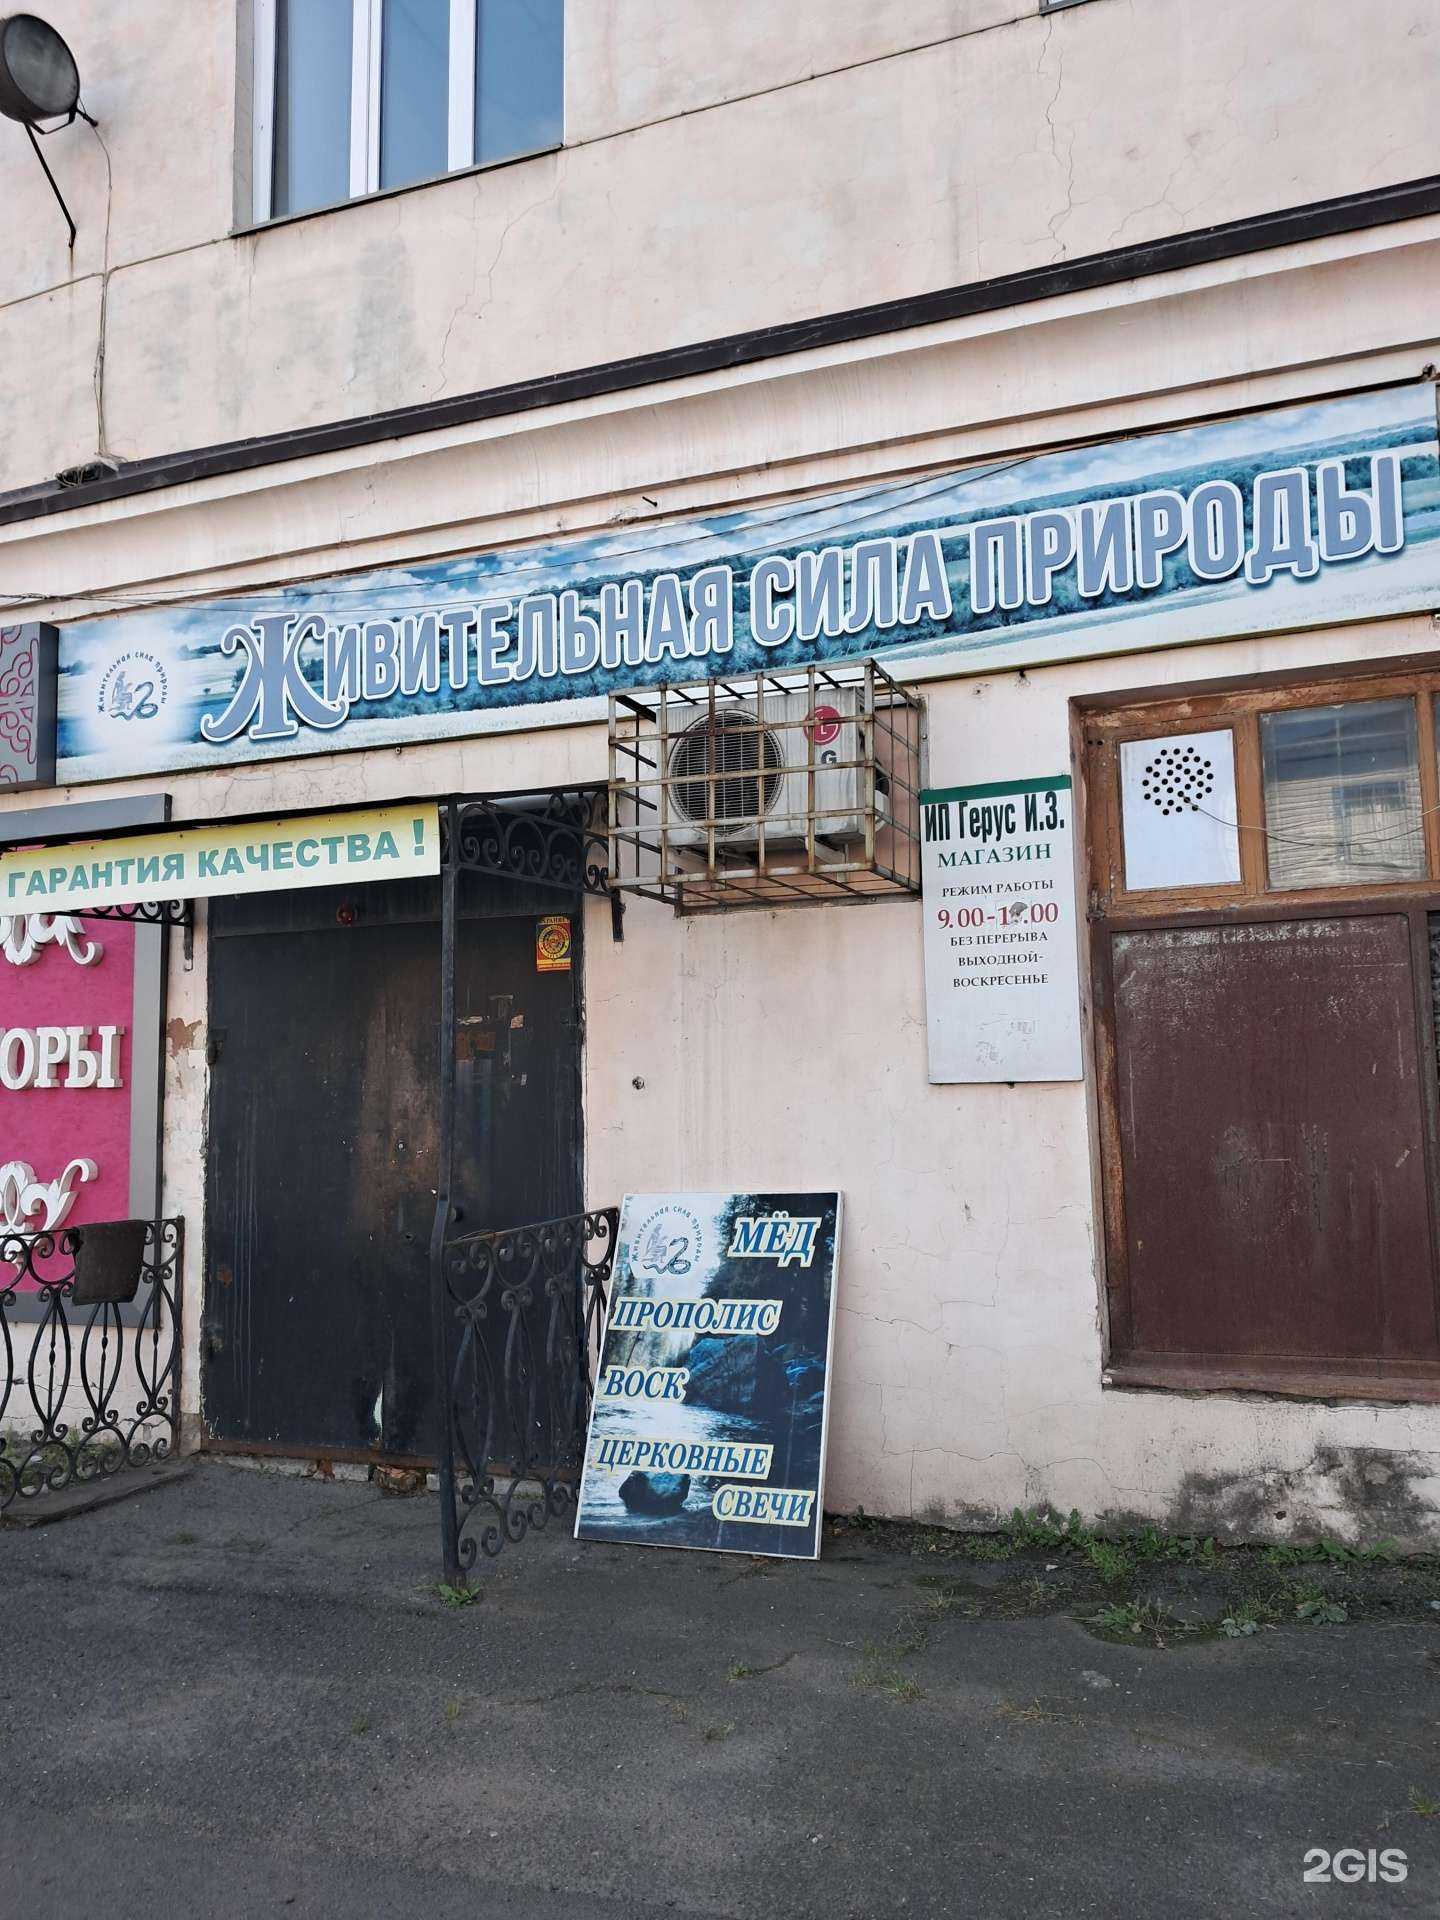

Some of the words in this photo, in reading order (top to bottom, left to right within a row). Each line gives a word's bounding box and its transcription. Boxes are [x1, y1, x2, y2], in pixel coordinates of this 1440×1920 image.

[750, 530, 952, 646] СИЛА
[970, 455, 1404, 614] ПРИРОДЫ
[925, 803, 951, 842] ИП
[959, 801, 1016, 843] Герус
[1024, 791, 1065, 832] И.З.
[8, 853, 184, 898] ГАРАНТИЯ
[198, 831, 400, 877] КАЧЕСТВА
[938, 843, 1052, 868] МАГАЗИН
[942, 883, 992, 897] РЕЖИМ
[996, 880, 1054, 894] РАБОТЫ
[937, 901, 1059, 929] 9.00-1.00
[950, 936, 973, 947] БЕЗ
[976, 931, 1049, 945] ПЕРЕРЫВА
[953, 974, 1049, 988] ВОСКРЕСЕНЬЕ
[0, 1026, 120, 1090] ОРЫ
[729, 1212, 819, 1266] МЁД
[612, 1300, 781, 1333] ПРОПОЛИС
[604, 1368, 688, 1400] ВОСК
[598, 1440, 770, 1476] ЦЕРКОВНЫЕ
[715, 1488, 812, 1523] СВЕЧИ
